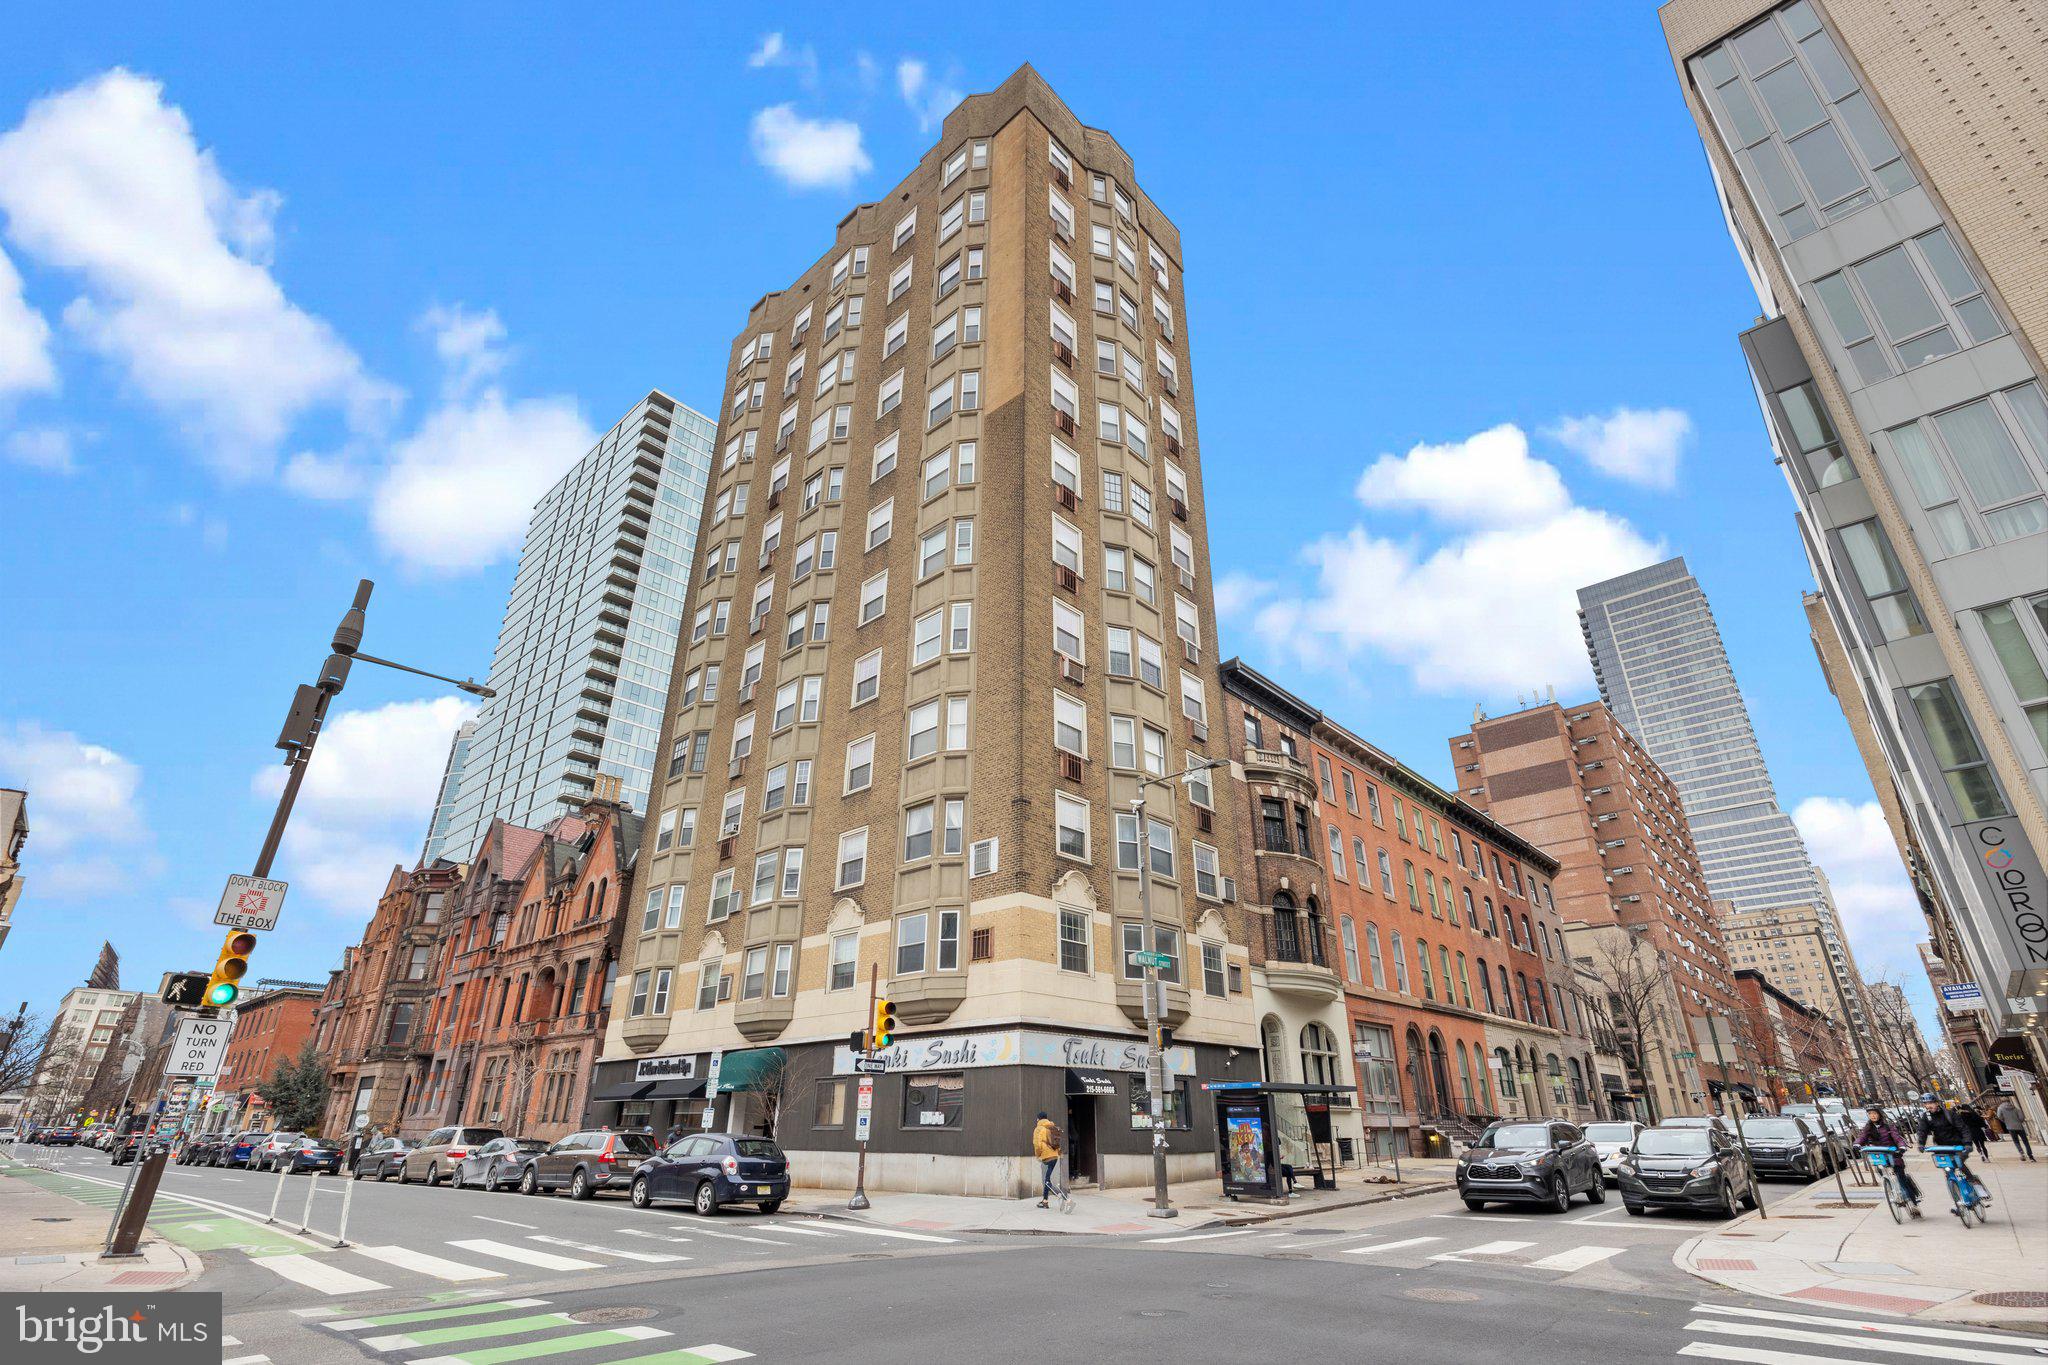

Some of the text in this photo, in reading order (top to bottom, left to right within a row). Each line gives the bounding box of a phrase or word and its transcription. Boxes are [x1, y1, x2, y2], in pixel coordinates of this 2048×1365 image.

[257, 880, 286, 893] BLOCK
[220, 912, 273, 929] THE BOX
[192, 1023, 217, 1036] NO
[186, 1037, 218, 1047] TURN
[188, 1049, 207, 1059] ON
[868, 1039, 977, 1068] uki Sushi
[1063, 1037, 1151, 1070] Tsuki Sus
[1994, 1053, 2025, 1061] Florist
[181, 1061, 205, 1072] RED
